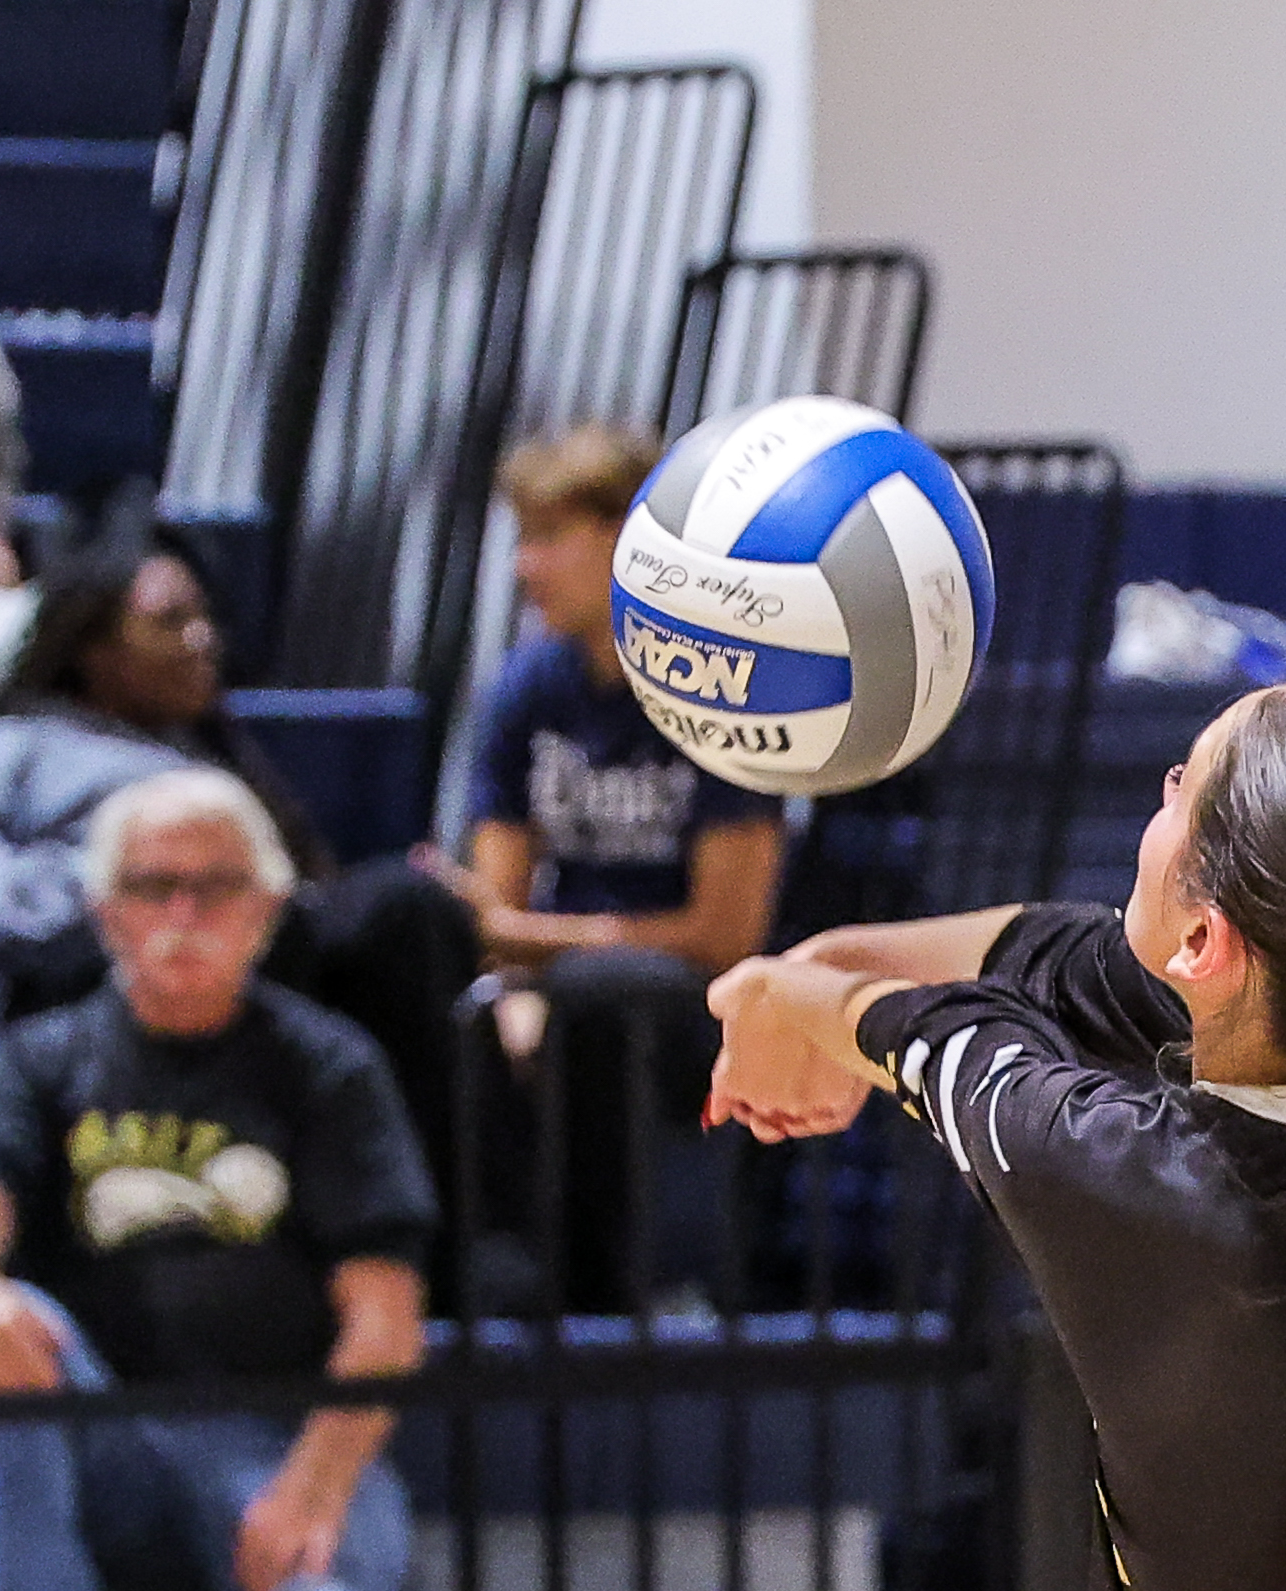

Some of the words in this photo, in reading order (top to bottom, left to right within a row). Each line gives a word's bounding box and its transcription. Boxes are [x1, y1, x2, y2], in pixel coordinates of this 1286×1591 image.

[625, 548, 688, 594] Touch
[696, 576, 784, 627] Super
[624, 611, 755, 706] NCAA
